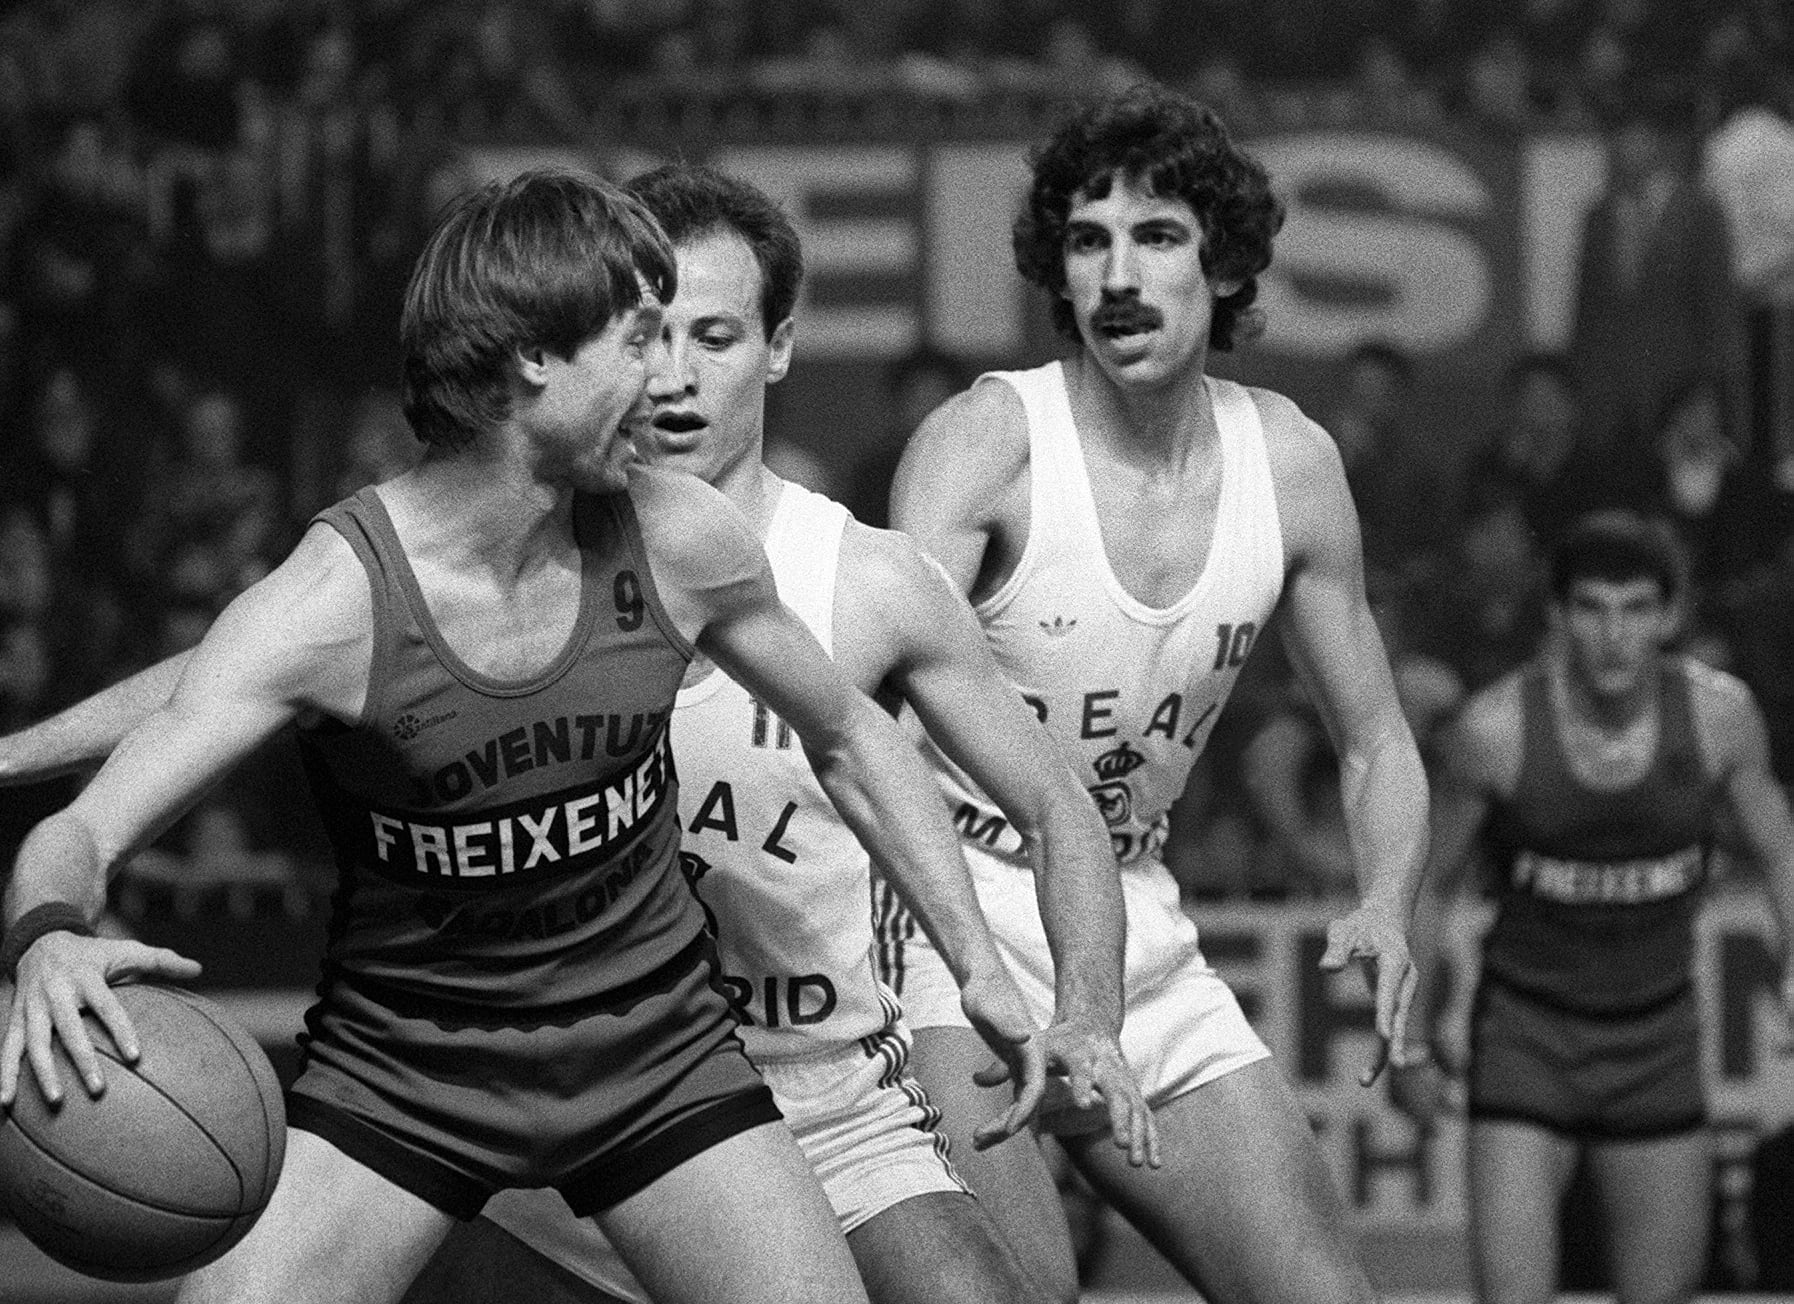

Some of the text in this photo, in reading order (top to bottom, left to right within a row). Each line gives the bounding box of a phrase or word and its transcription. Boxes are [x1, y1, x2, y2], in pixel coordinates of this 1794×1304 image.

[613, 569, 645, 633] 9
[1213, 621, 1255, 671] 10
[1020, 688, 1218, 749] EAL
[369, 725, 667, 878] FREIXENET
[687, 780, 799, 865] AL
[722, 972, 838, 1029] RID
